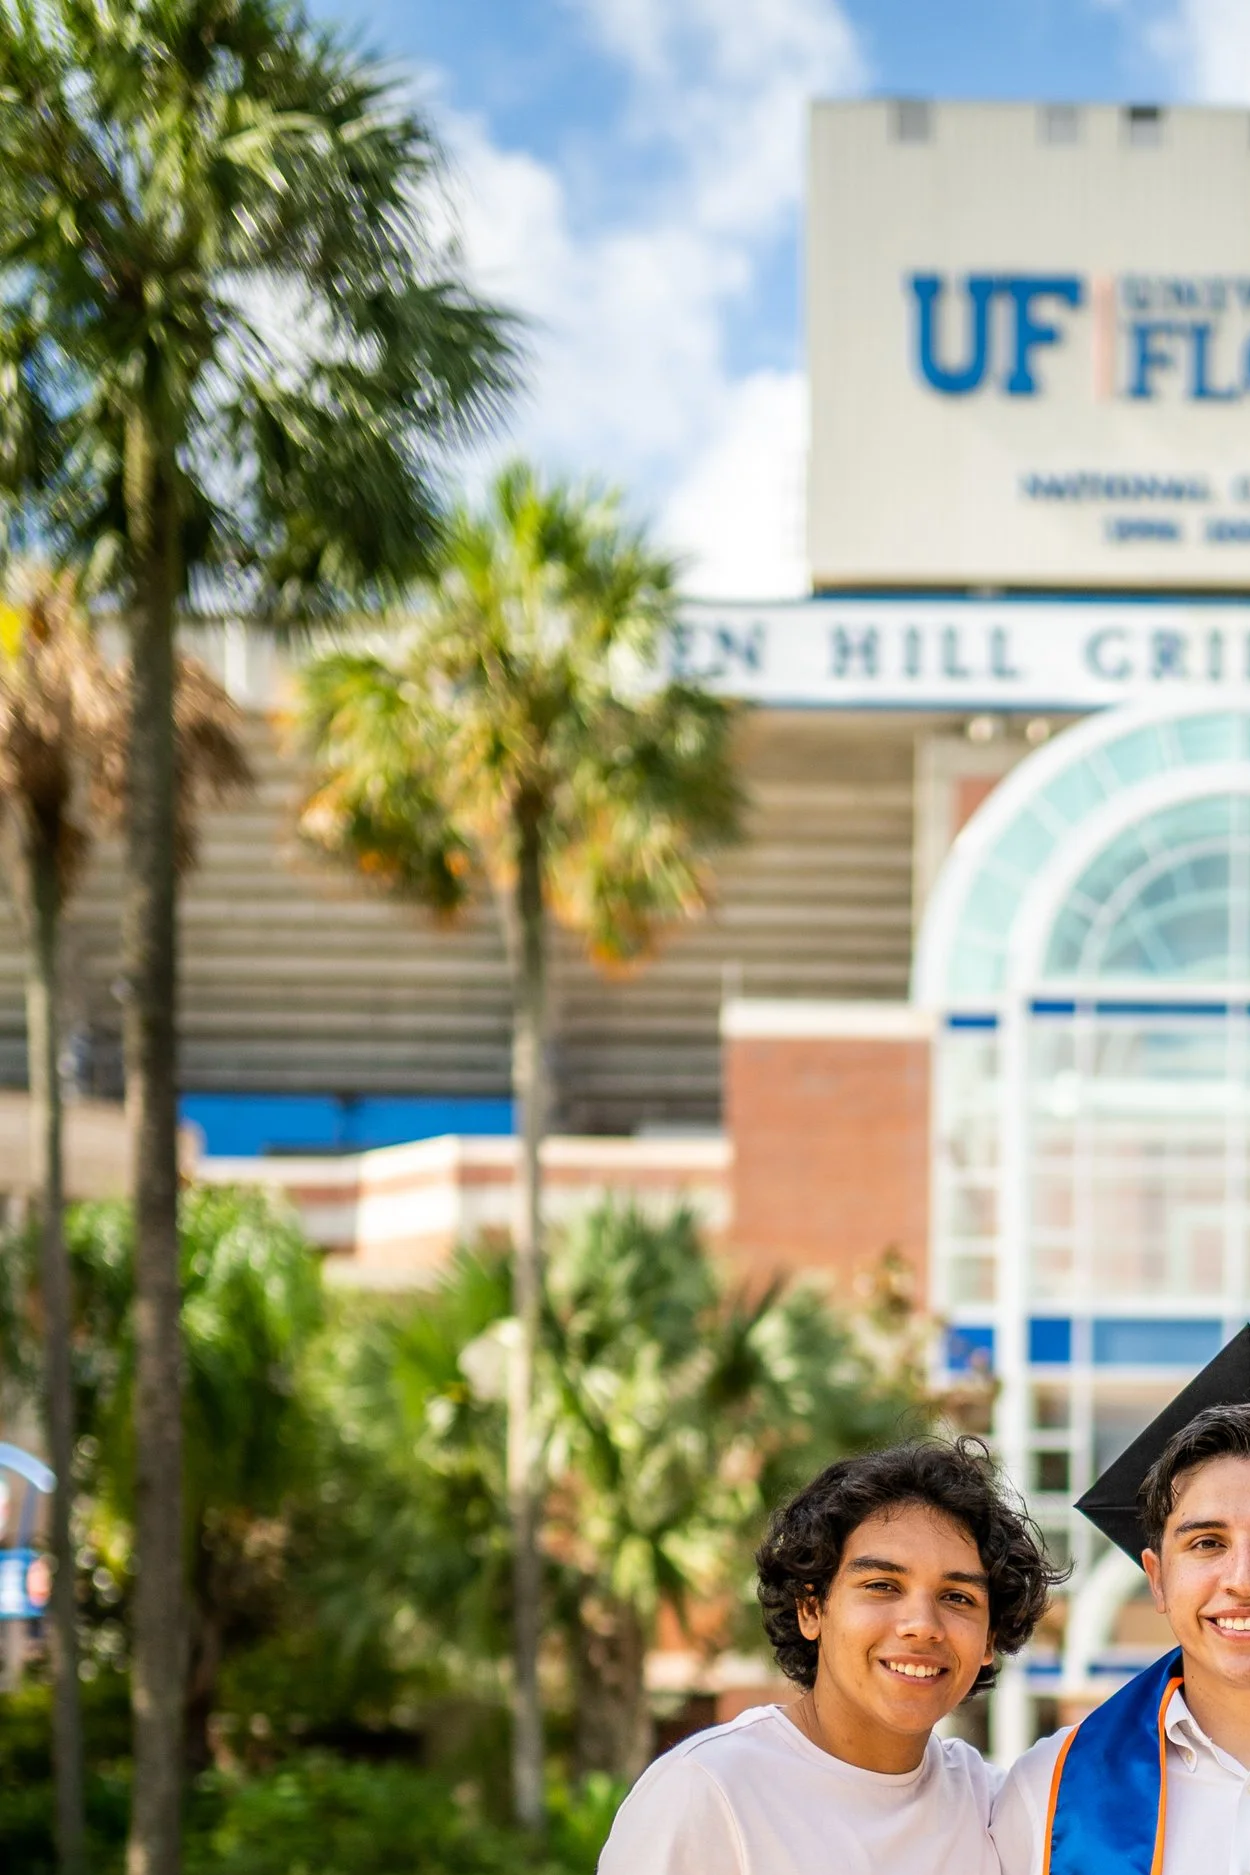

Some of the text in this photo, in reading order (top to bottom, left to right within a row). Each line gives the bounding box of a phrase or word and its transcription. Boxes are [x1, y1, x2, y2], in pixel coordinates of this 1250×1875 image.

[908, 273, 1083, 396] UF
[668, 620, 766, 681] EN
[828, 622, 1022, 680] HILL
